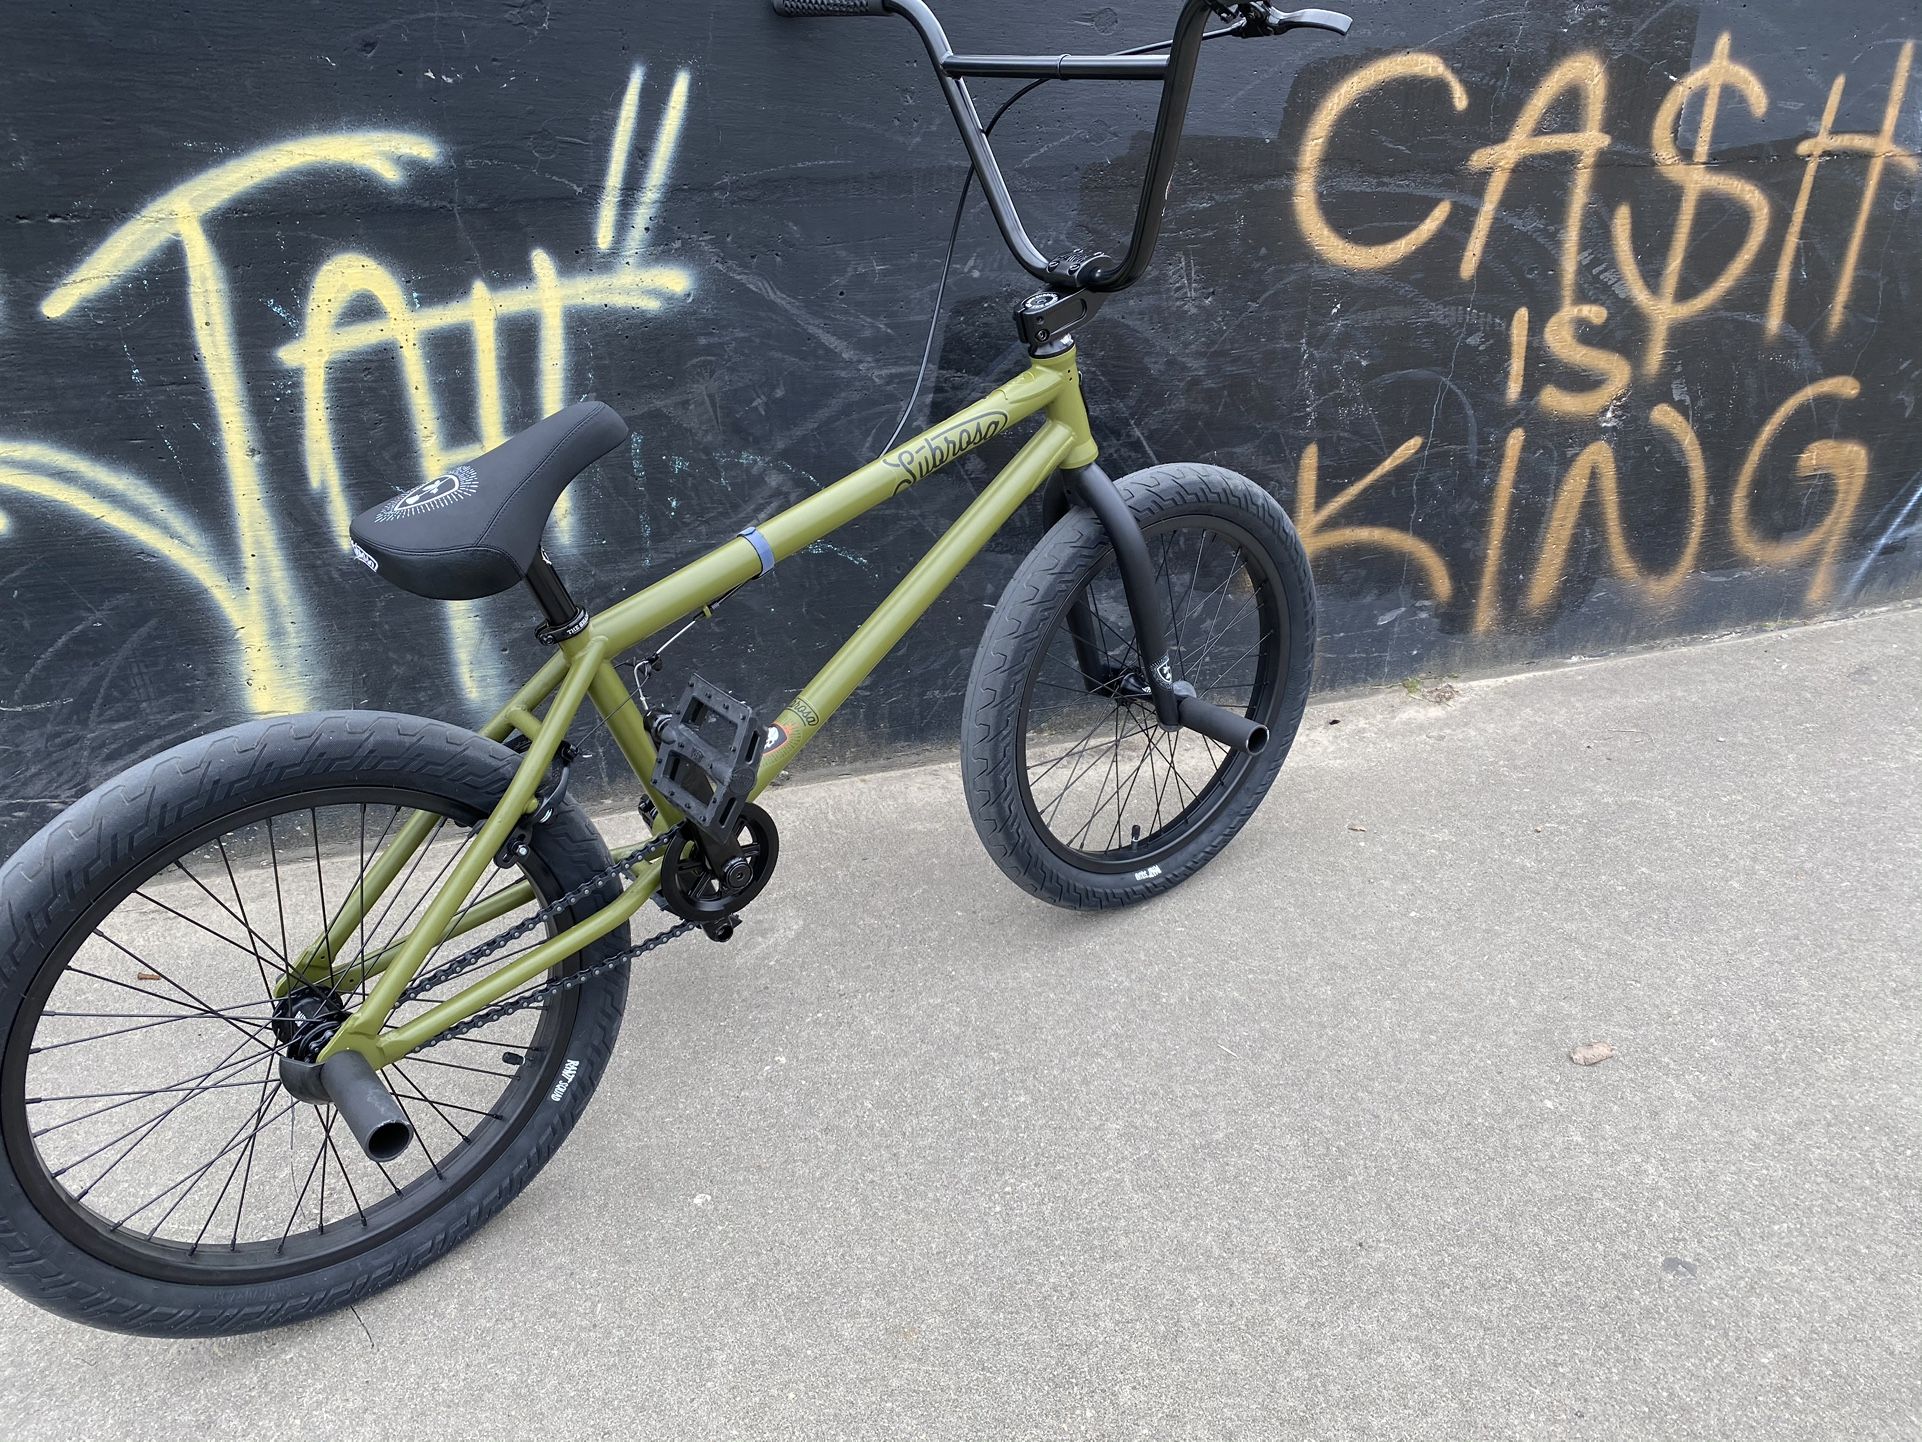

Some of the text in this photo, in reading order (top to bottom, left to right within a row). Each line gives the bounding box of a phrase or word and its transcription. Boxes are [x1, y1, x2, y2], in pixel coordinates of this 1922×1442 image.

[1294, 32, 1920, 381] CA$H
[1295, 375, 1869, 636] KING
[551, 1080, 569, 1102] SQUAD
